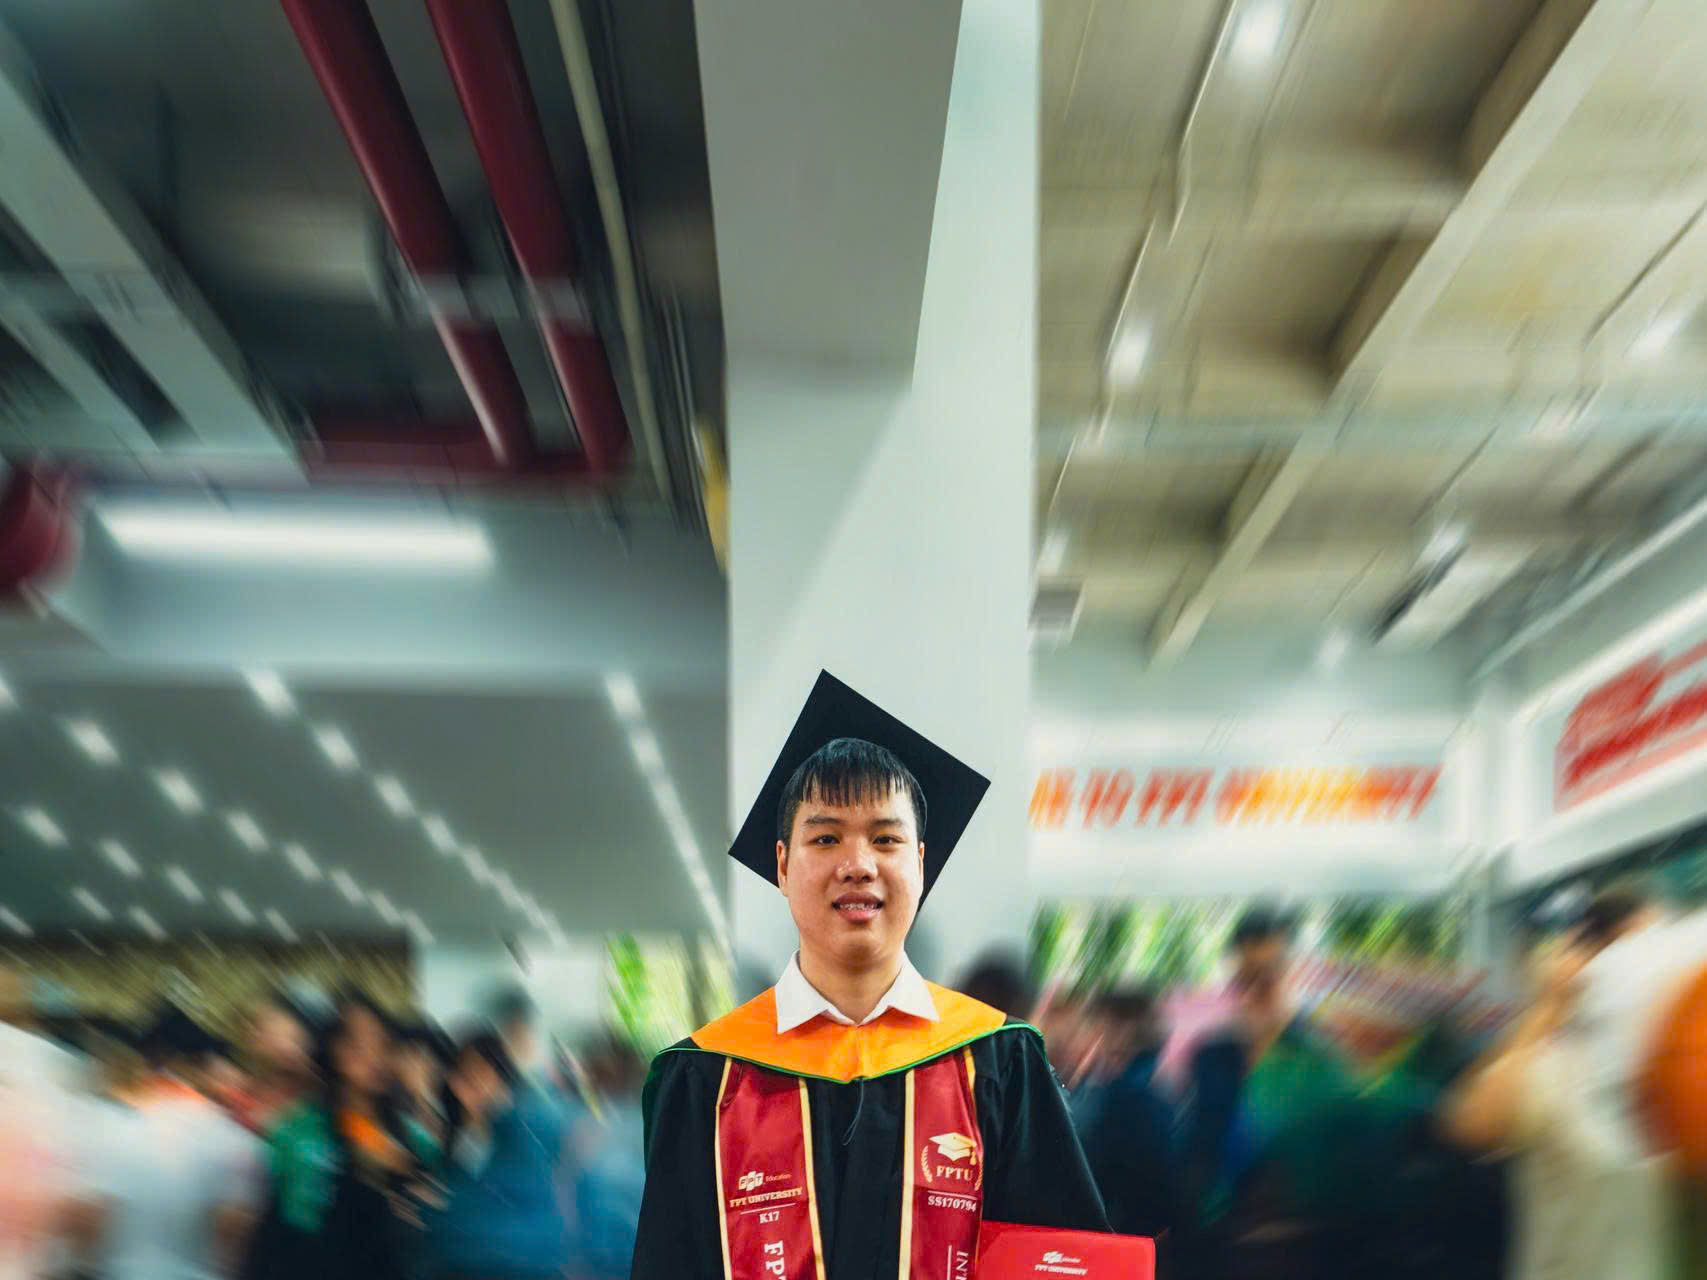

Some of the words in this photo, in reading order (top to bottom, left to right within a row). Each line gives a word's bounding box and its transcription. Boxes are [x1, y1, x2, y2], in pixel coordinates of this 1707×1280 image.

[730, 1198, 747, 1208] FPT
[748, 1187, 802, 1204] UNIVERSITY
[759, 1211, 780, 1224] K17
